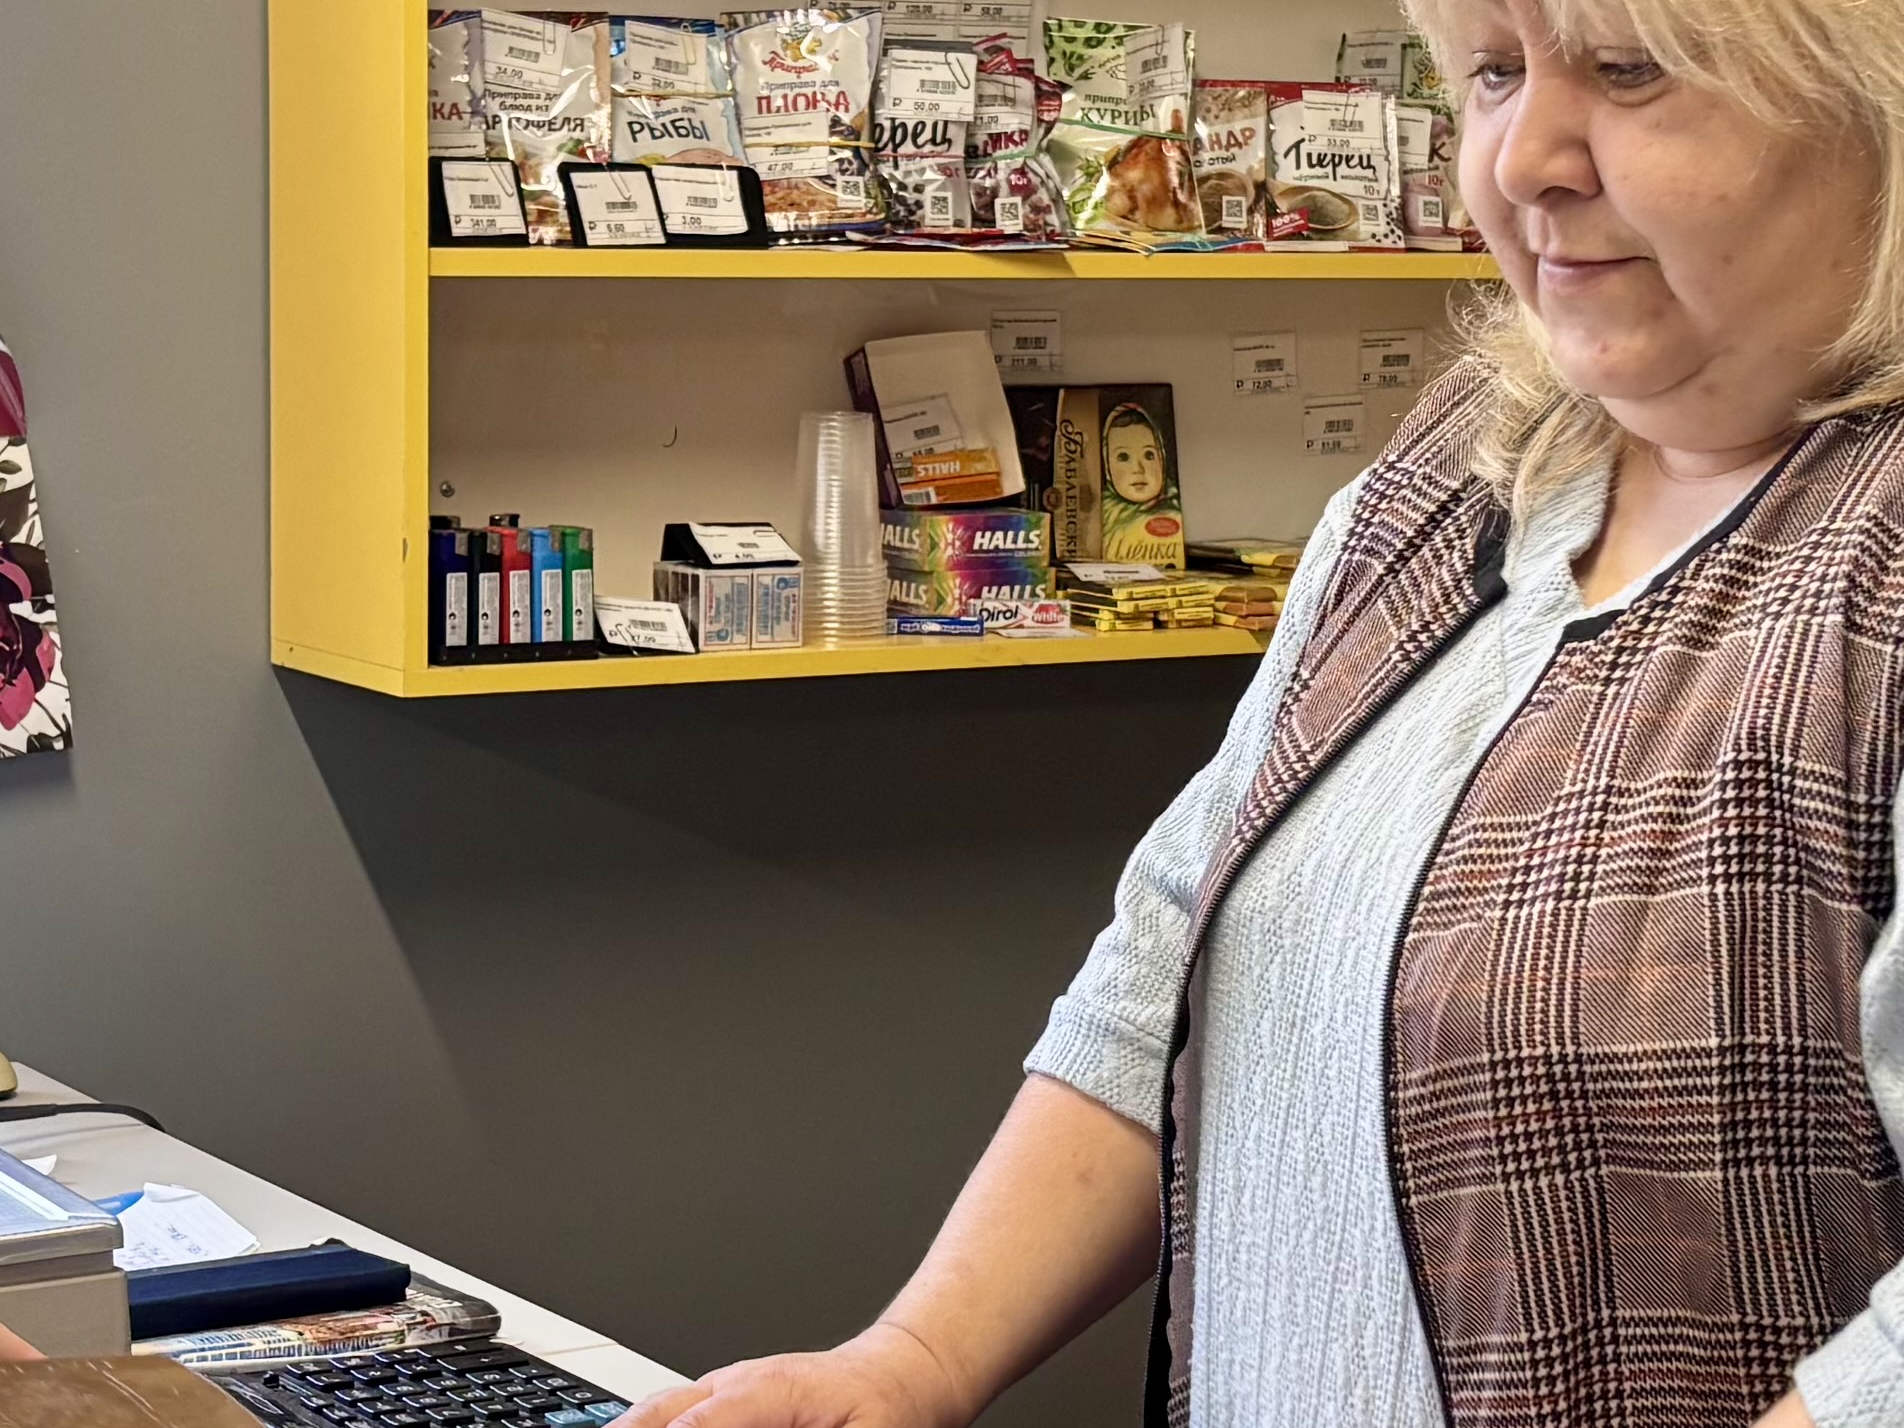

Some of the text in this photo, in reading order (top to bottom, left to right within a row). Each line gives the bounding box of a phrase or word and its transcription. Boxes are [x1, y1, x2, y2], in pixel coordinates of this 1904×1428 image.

[628, 117, 711, 143] РЫБЫ
[873, 119, 953, 160] ерец
[917, 460, 961, 477] HALLS
[973, 530, 1042, 551] HALLS
